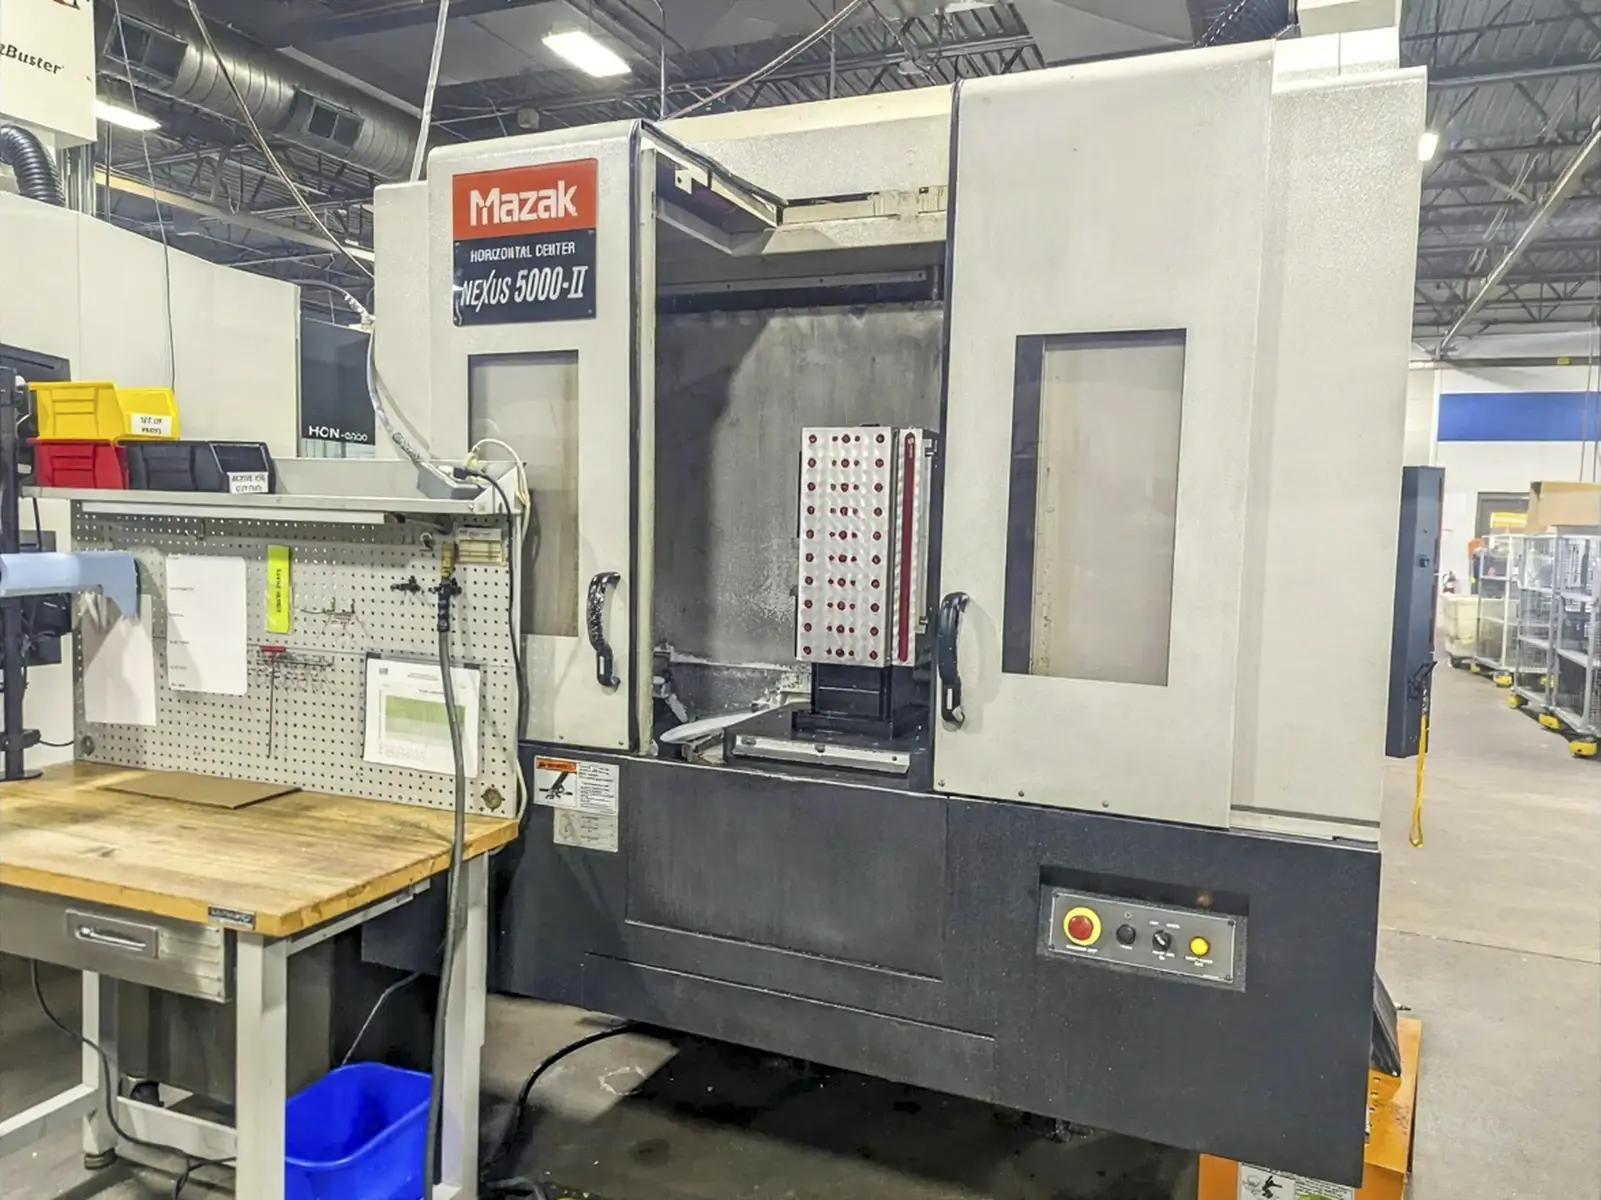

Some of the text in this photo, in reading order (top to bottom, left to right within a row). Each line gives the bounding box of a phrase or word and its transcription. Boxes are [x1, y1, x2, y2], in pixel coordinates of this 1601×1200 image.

[469, 180, 578, 227] Mazak
[470, 241, 576, 263] HORIZONTAL CENTER
[460, 265, 589, 313] NEXUS 5000-II
